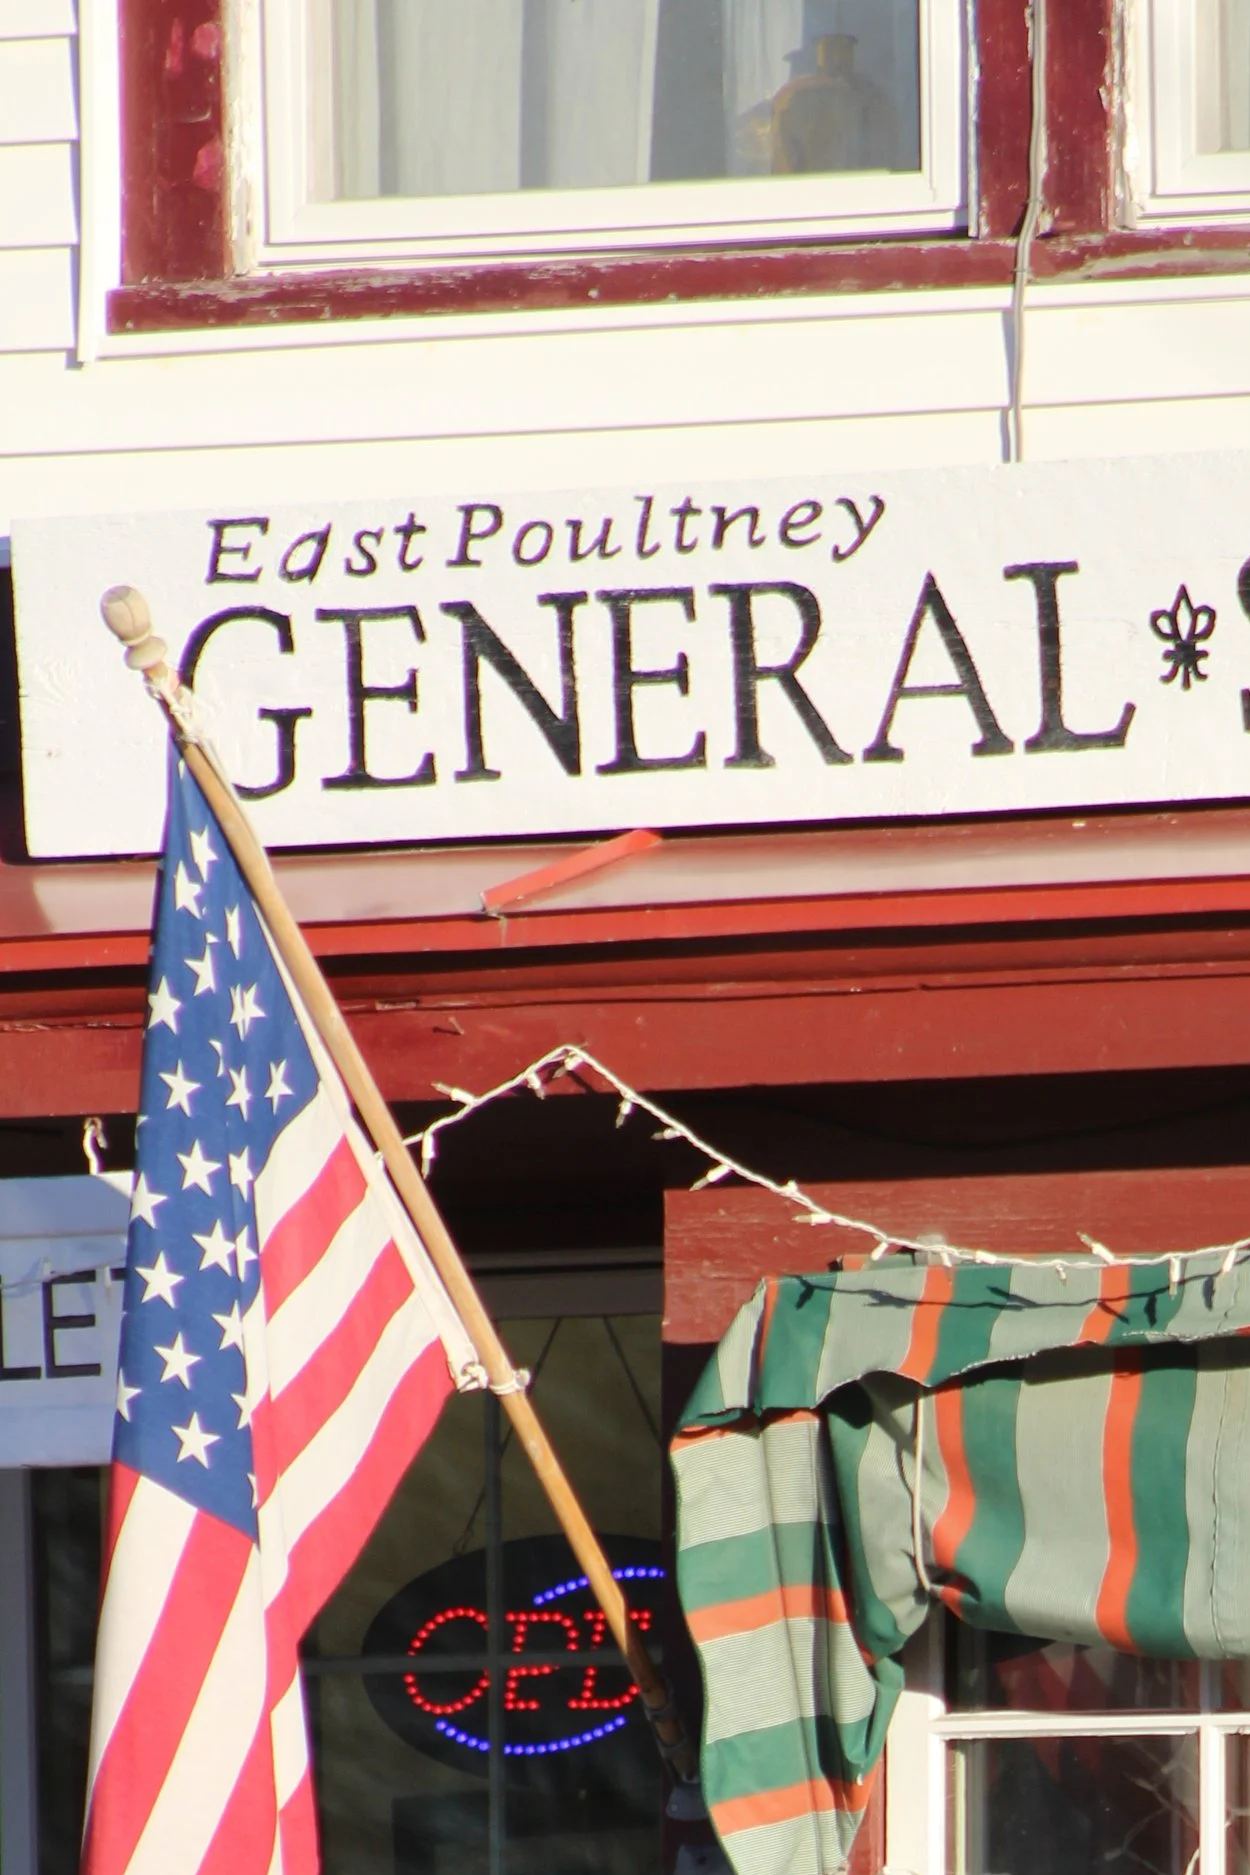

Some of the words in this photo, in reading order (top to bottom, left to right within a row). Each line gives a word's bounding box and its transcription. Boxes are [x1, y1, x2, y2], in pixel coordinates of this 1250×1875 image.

[204, 511, 425, 587] East
[446, 490, 887, 566] Poultney
[178, 558, 1137, 801] GENERAL
